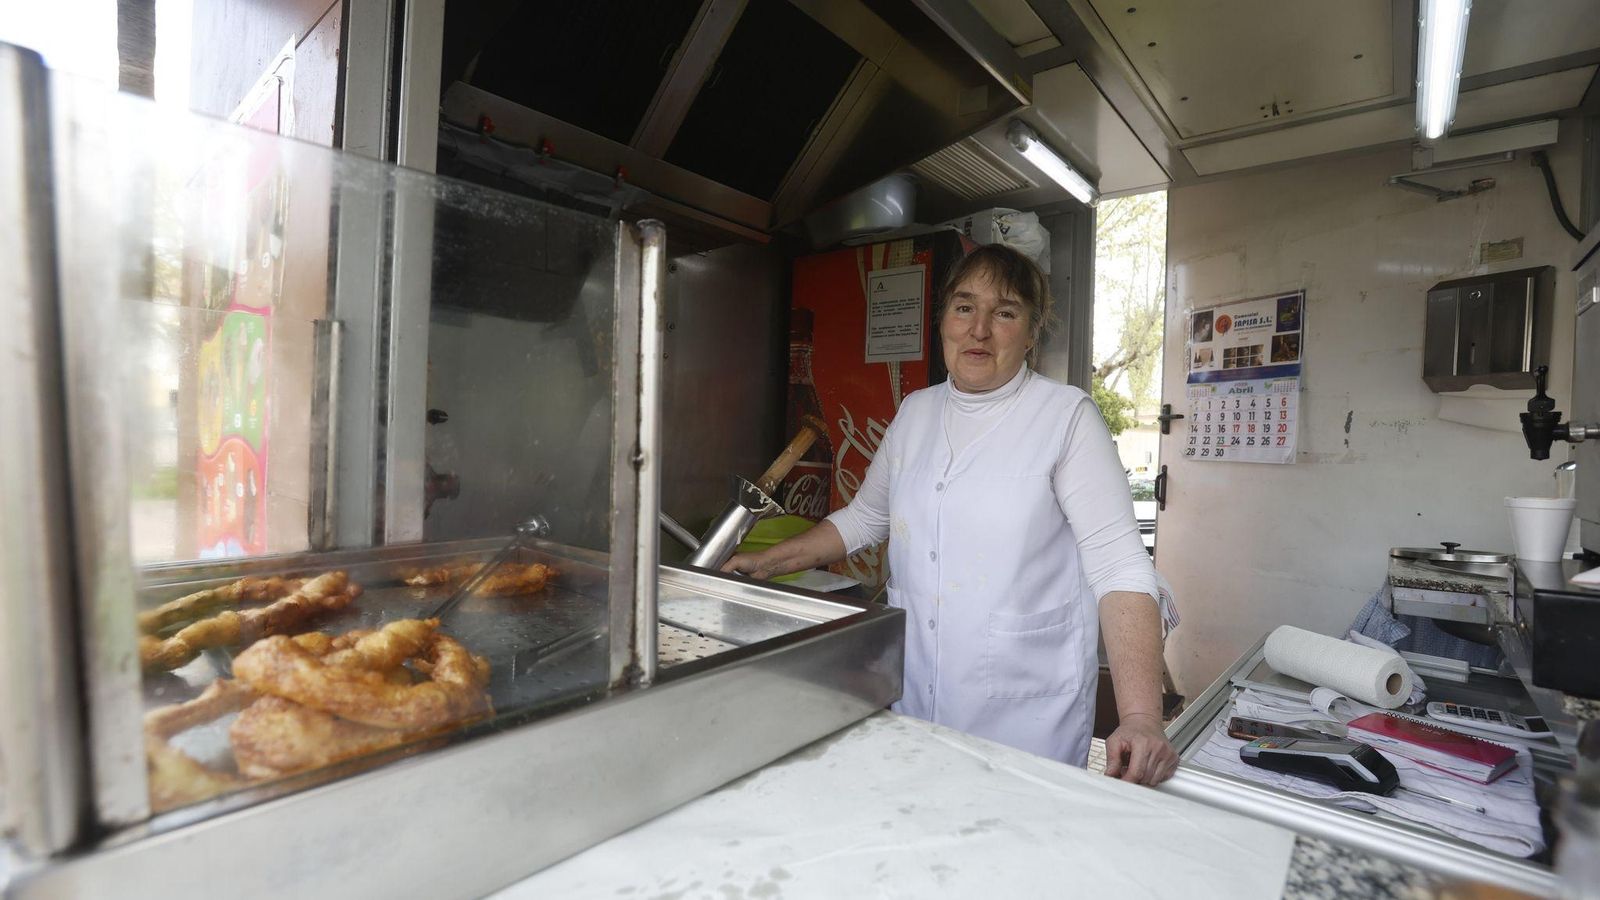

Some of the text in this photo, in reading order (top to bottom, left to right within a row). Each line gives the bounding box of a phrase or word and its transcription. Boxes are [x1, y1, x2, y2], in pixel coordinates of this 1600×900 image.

[1234, 318, 1258, 328] SAPISA
[1228, 386, 1253, 395] Abril
[1208, 397, 1287, 409] 1 2 3 4 5 6
[1193, 410, 1287, 421] 7 8 9 10 11 12 13
[1190, 423, 1287, 433] 14 15 16 17 18 19 20
[1189, 436, 1286, 446] 21 22 23 24 25 26 27
[1186, 448, 1224, 457] 28 29 30
